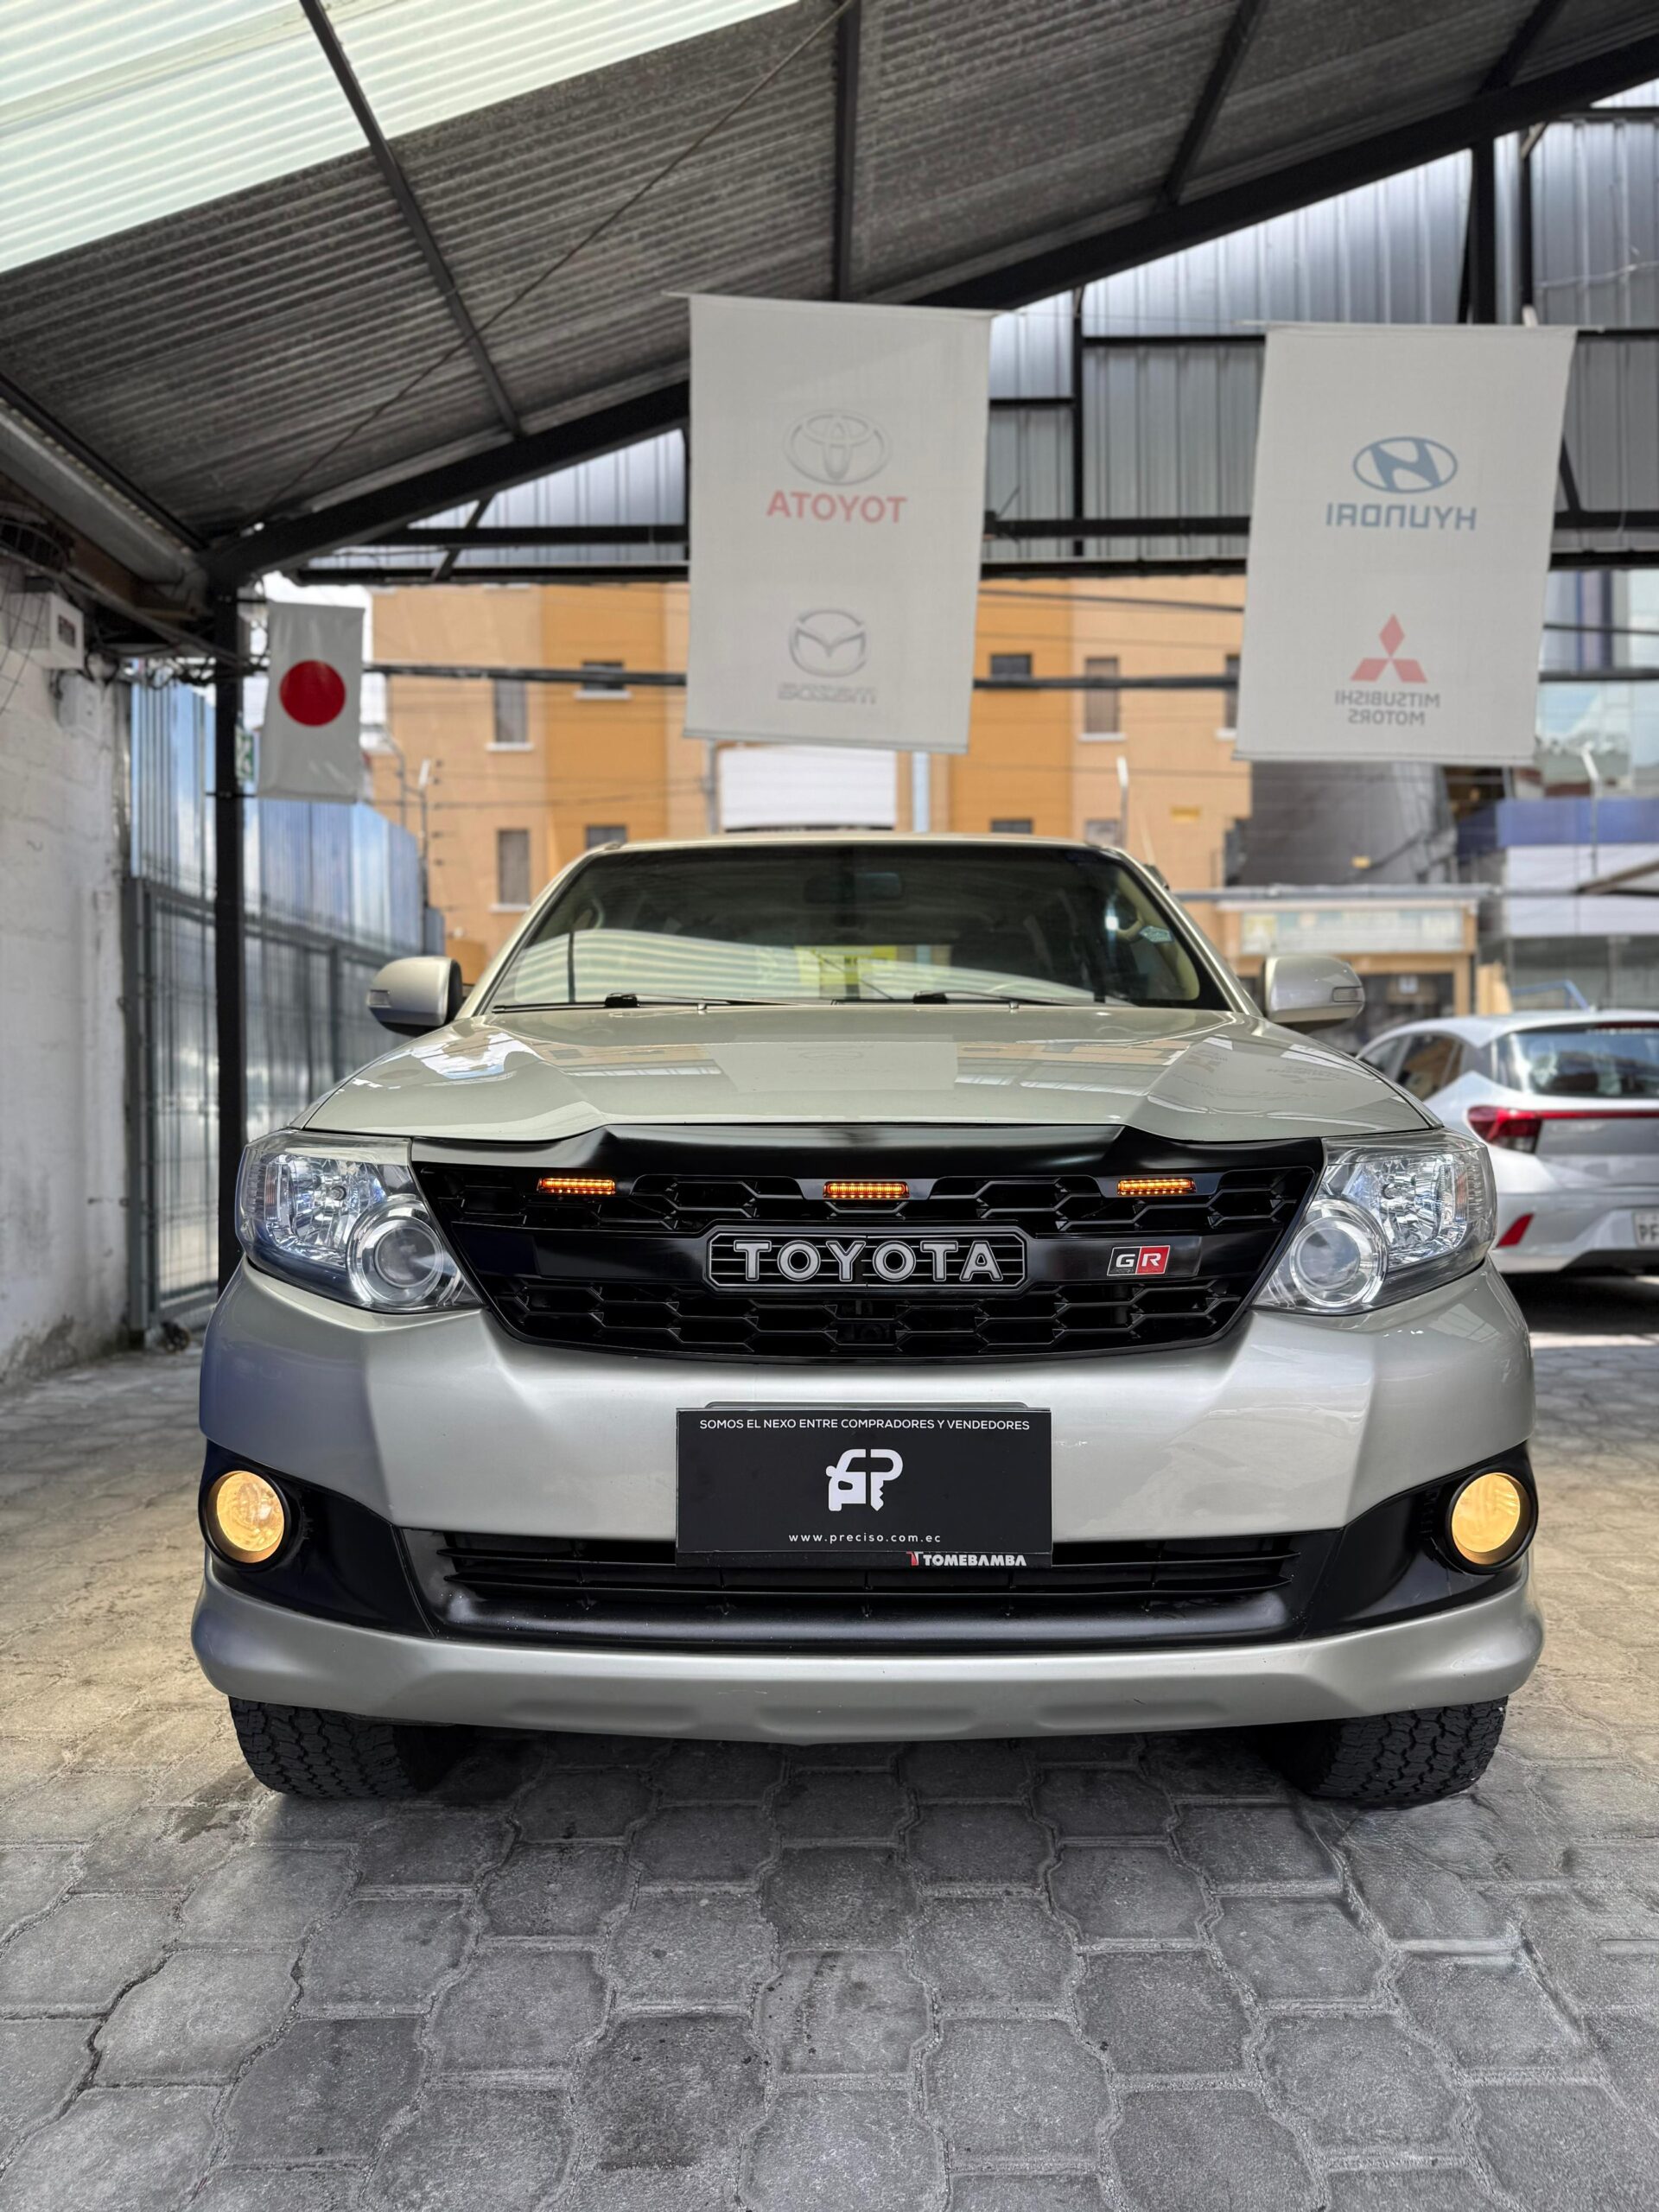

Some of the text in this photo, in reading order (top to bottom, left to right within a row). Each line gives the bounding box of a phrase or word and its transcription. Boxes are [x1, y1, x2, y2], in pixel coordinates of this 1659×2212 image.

[733, 1238, 1004, 1283] TOYOTA
[1116, 1252, 1162, 1268] GR
[699, 1419, 1030, 1431] SOMOS EL NEXO ENTRE COMPRADORES Y VENDEDORES
[788, 1532, 941, 1545] www.preciso.com.ec
[924, 1554, 1027, 1567] TOMEBAMBA
